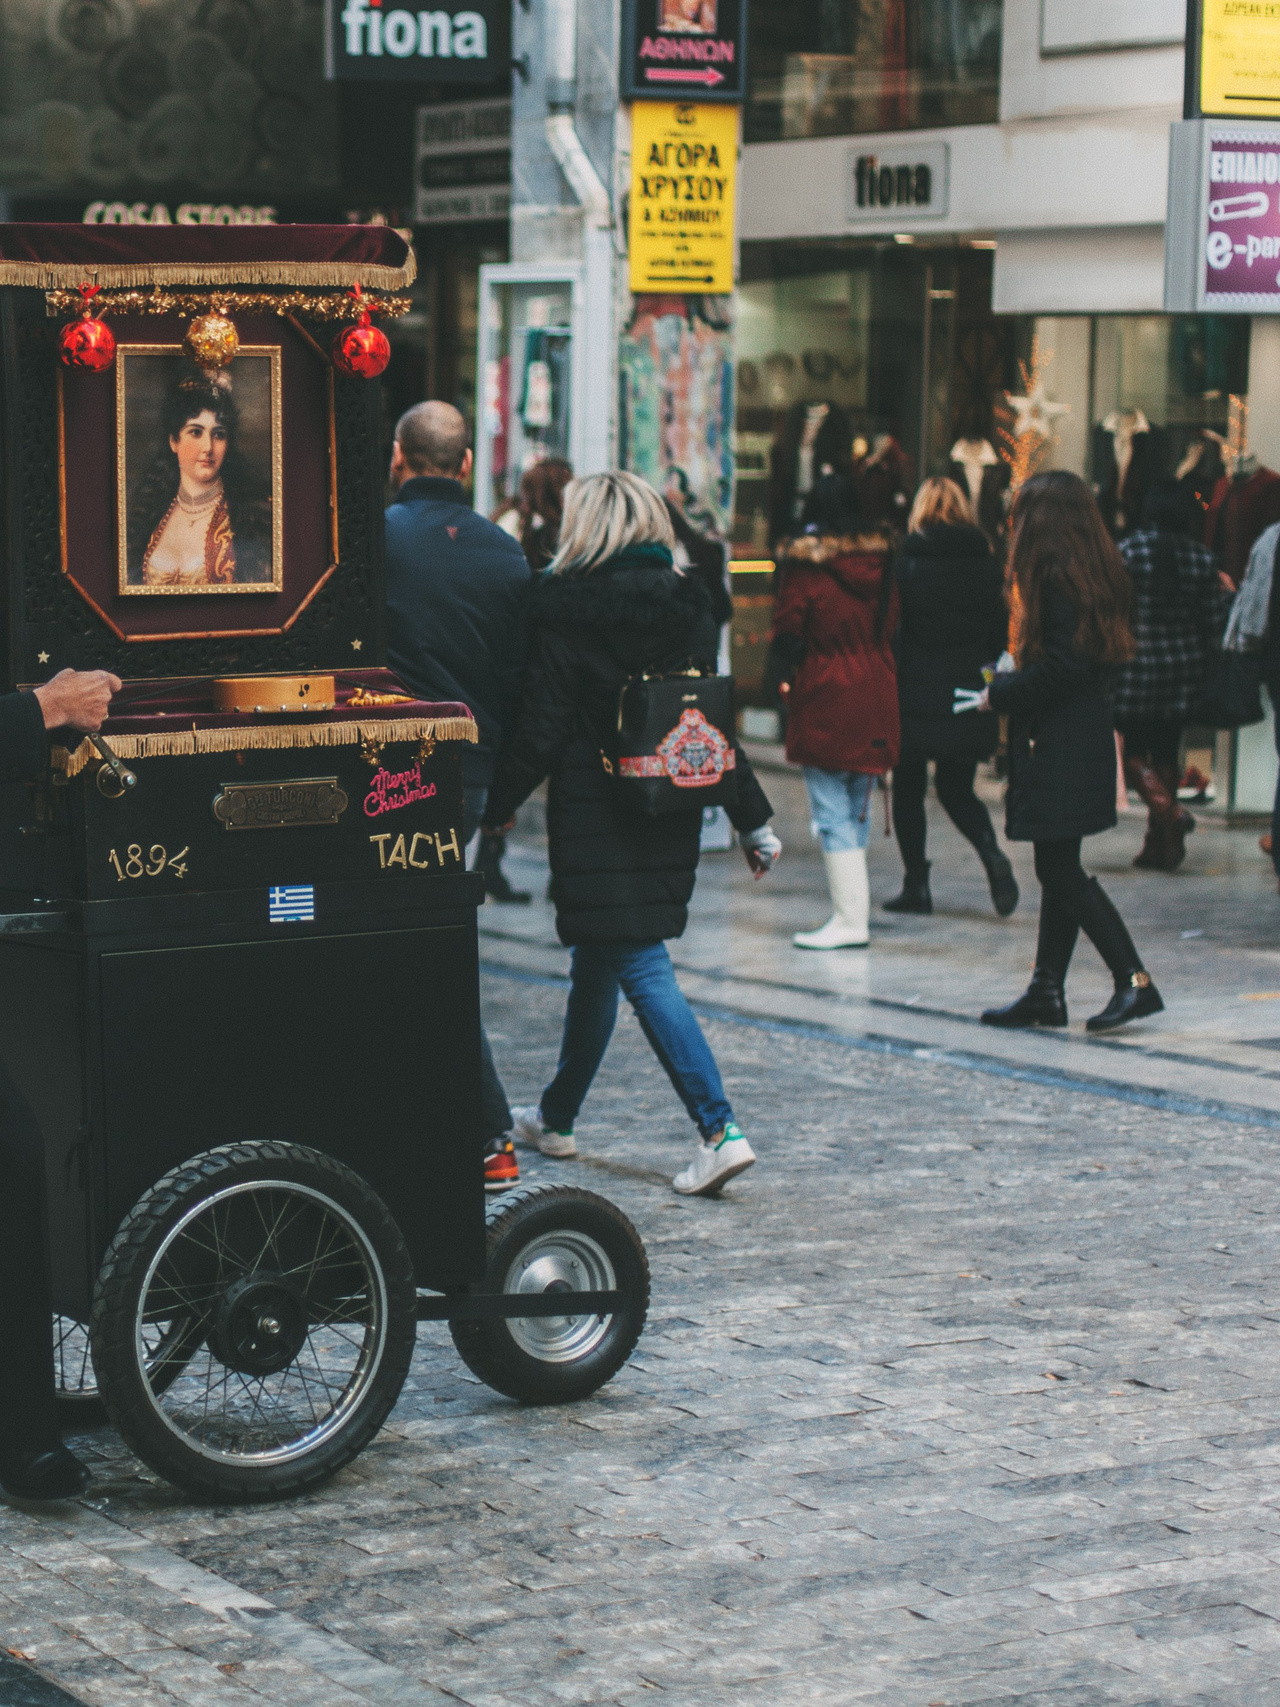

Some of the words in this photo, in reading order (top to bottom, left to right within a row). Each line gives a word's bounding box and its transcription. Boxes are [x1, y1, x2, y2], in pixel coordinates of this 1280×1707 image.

[341, 0, 488, 58] fiona
[647, 142, 721, 168] ΑΓΟΡΑ
[1209, 151, 1280, 184] ΕΠΙΔΙΟ
[640, 175, 727, 201] ΧΡΥΣΟΥ
[854, 154, 932, 208] fiona
[370, 761, 421, 792] Merry
[363, 782, 437, 817] Christmas
[108, 843, 190, 882] 1894
[369, 828, 461, 869] TACH
